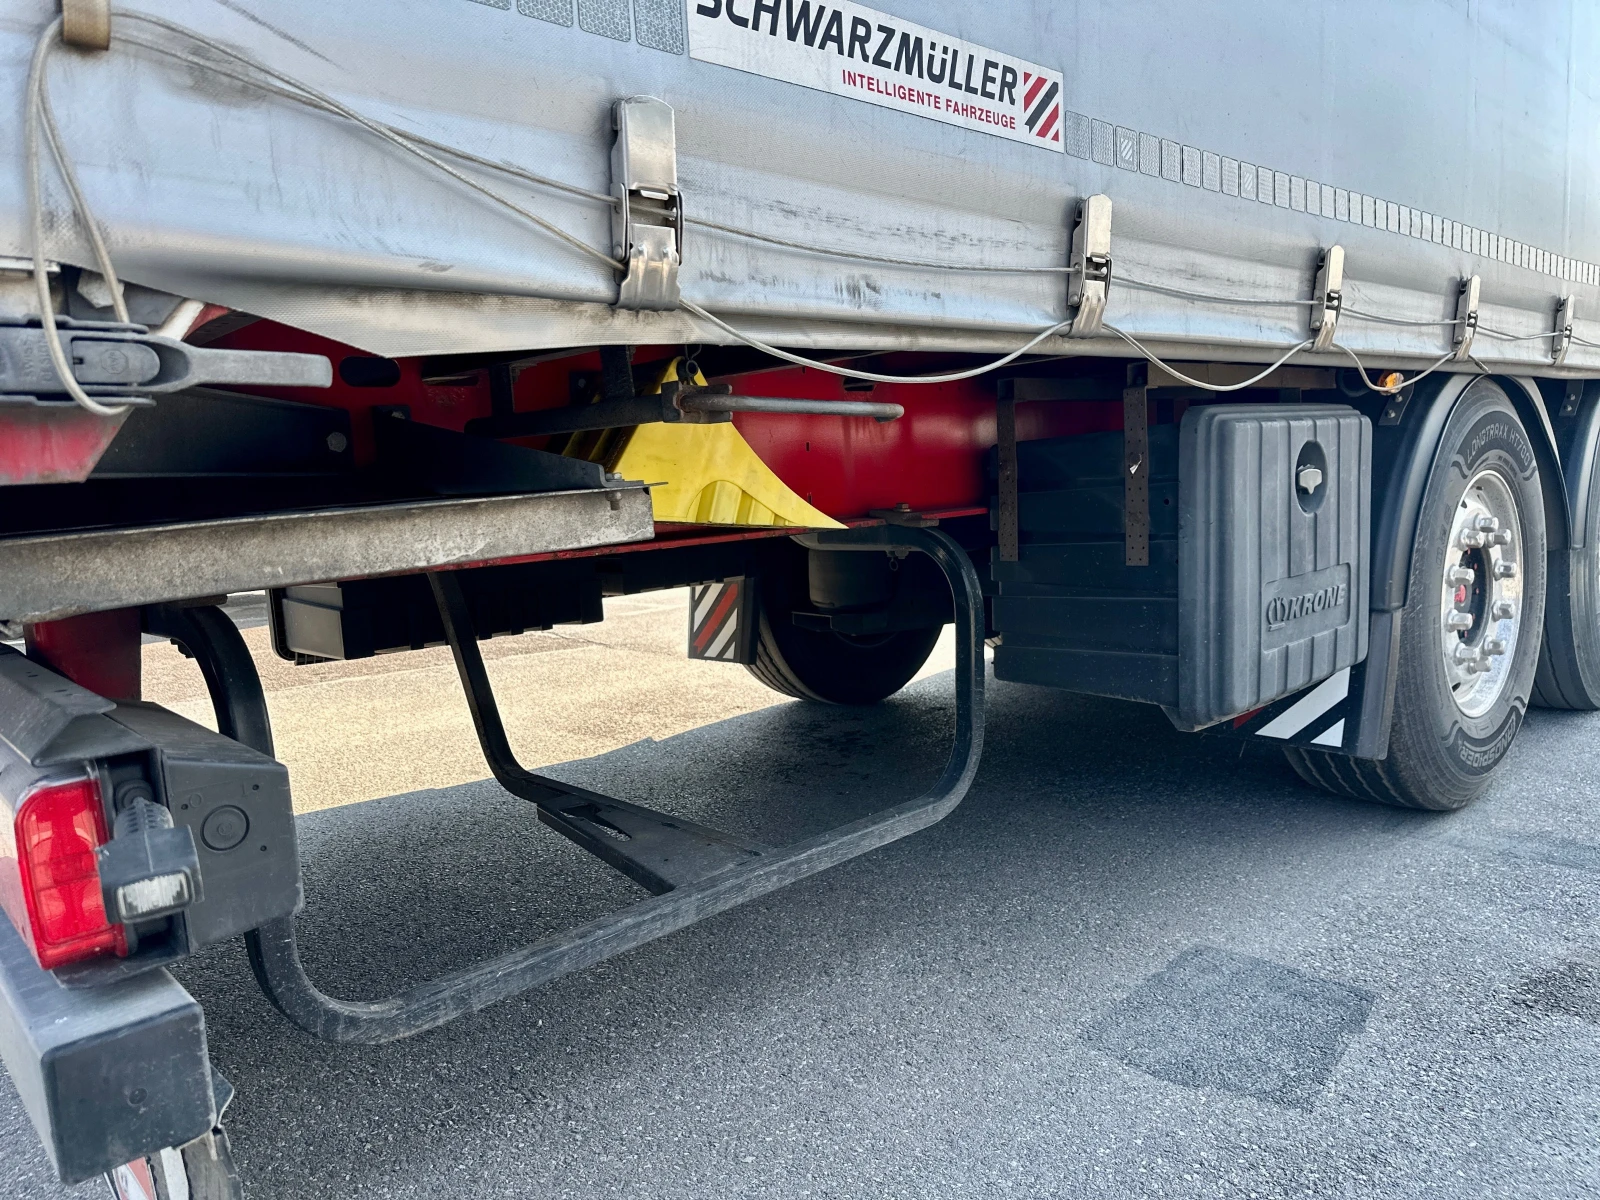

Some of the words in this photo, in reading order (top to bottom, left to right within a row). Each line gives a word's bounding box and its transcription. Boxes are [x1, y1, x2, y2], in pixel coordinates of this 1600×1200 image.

[842, 69, 941, 110] INTELLIGENTE
[945, 99, 1016, 129] FAHRZEUGE
[1467, 422, 1509, 462] LONGTRAXX
[1509, 427, 1531, 466] HT700
[1288, 583, 1346, 620] KRONE
